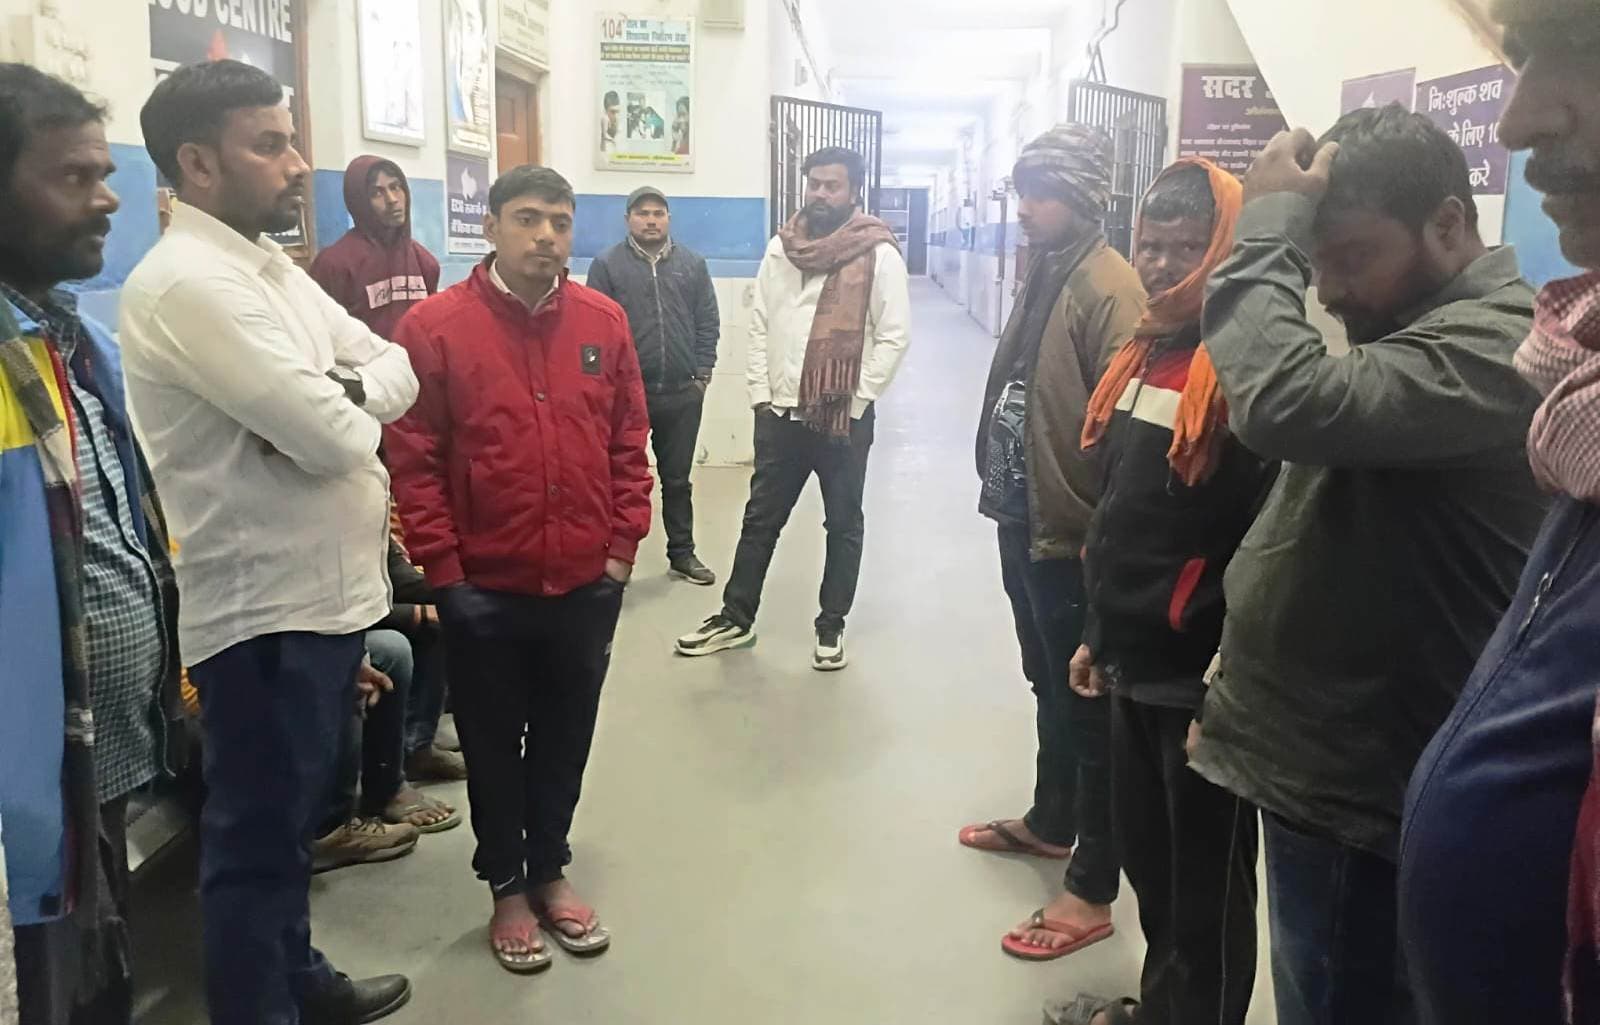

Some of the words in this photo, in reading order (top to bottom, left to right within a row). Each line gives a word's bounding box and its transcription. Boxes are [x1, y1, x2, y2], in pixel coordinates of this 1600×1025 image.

[602, 18, 622, 39] 104
[1201, 75, 1256, 98] सदर
[1480, 79, 1504, 102] शव
[1460, 119, 1486, 148] लिए
